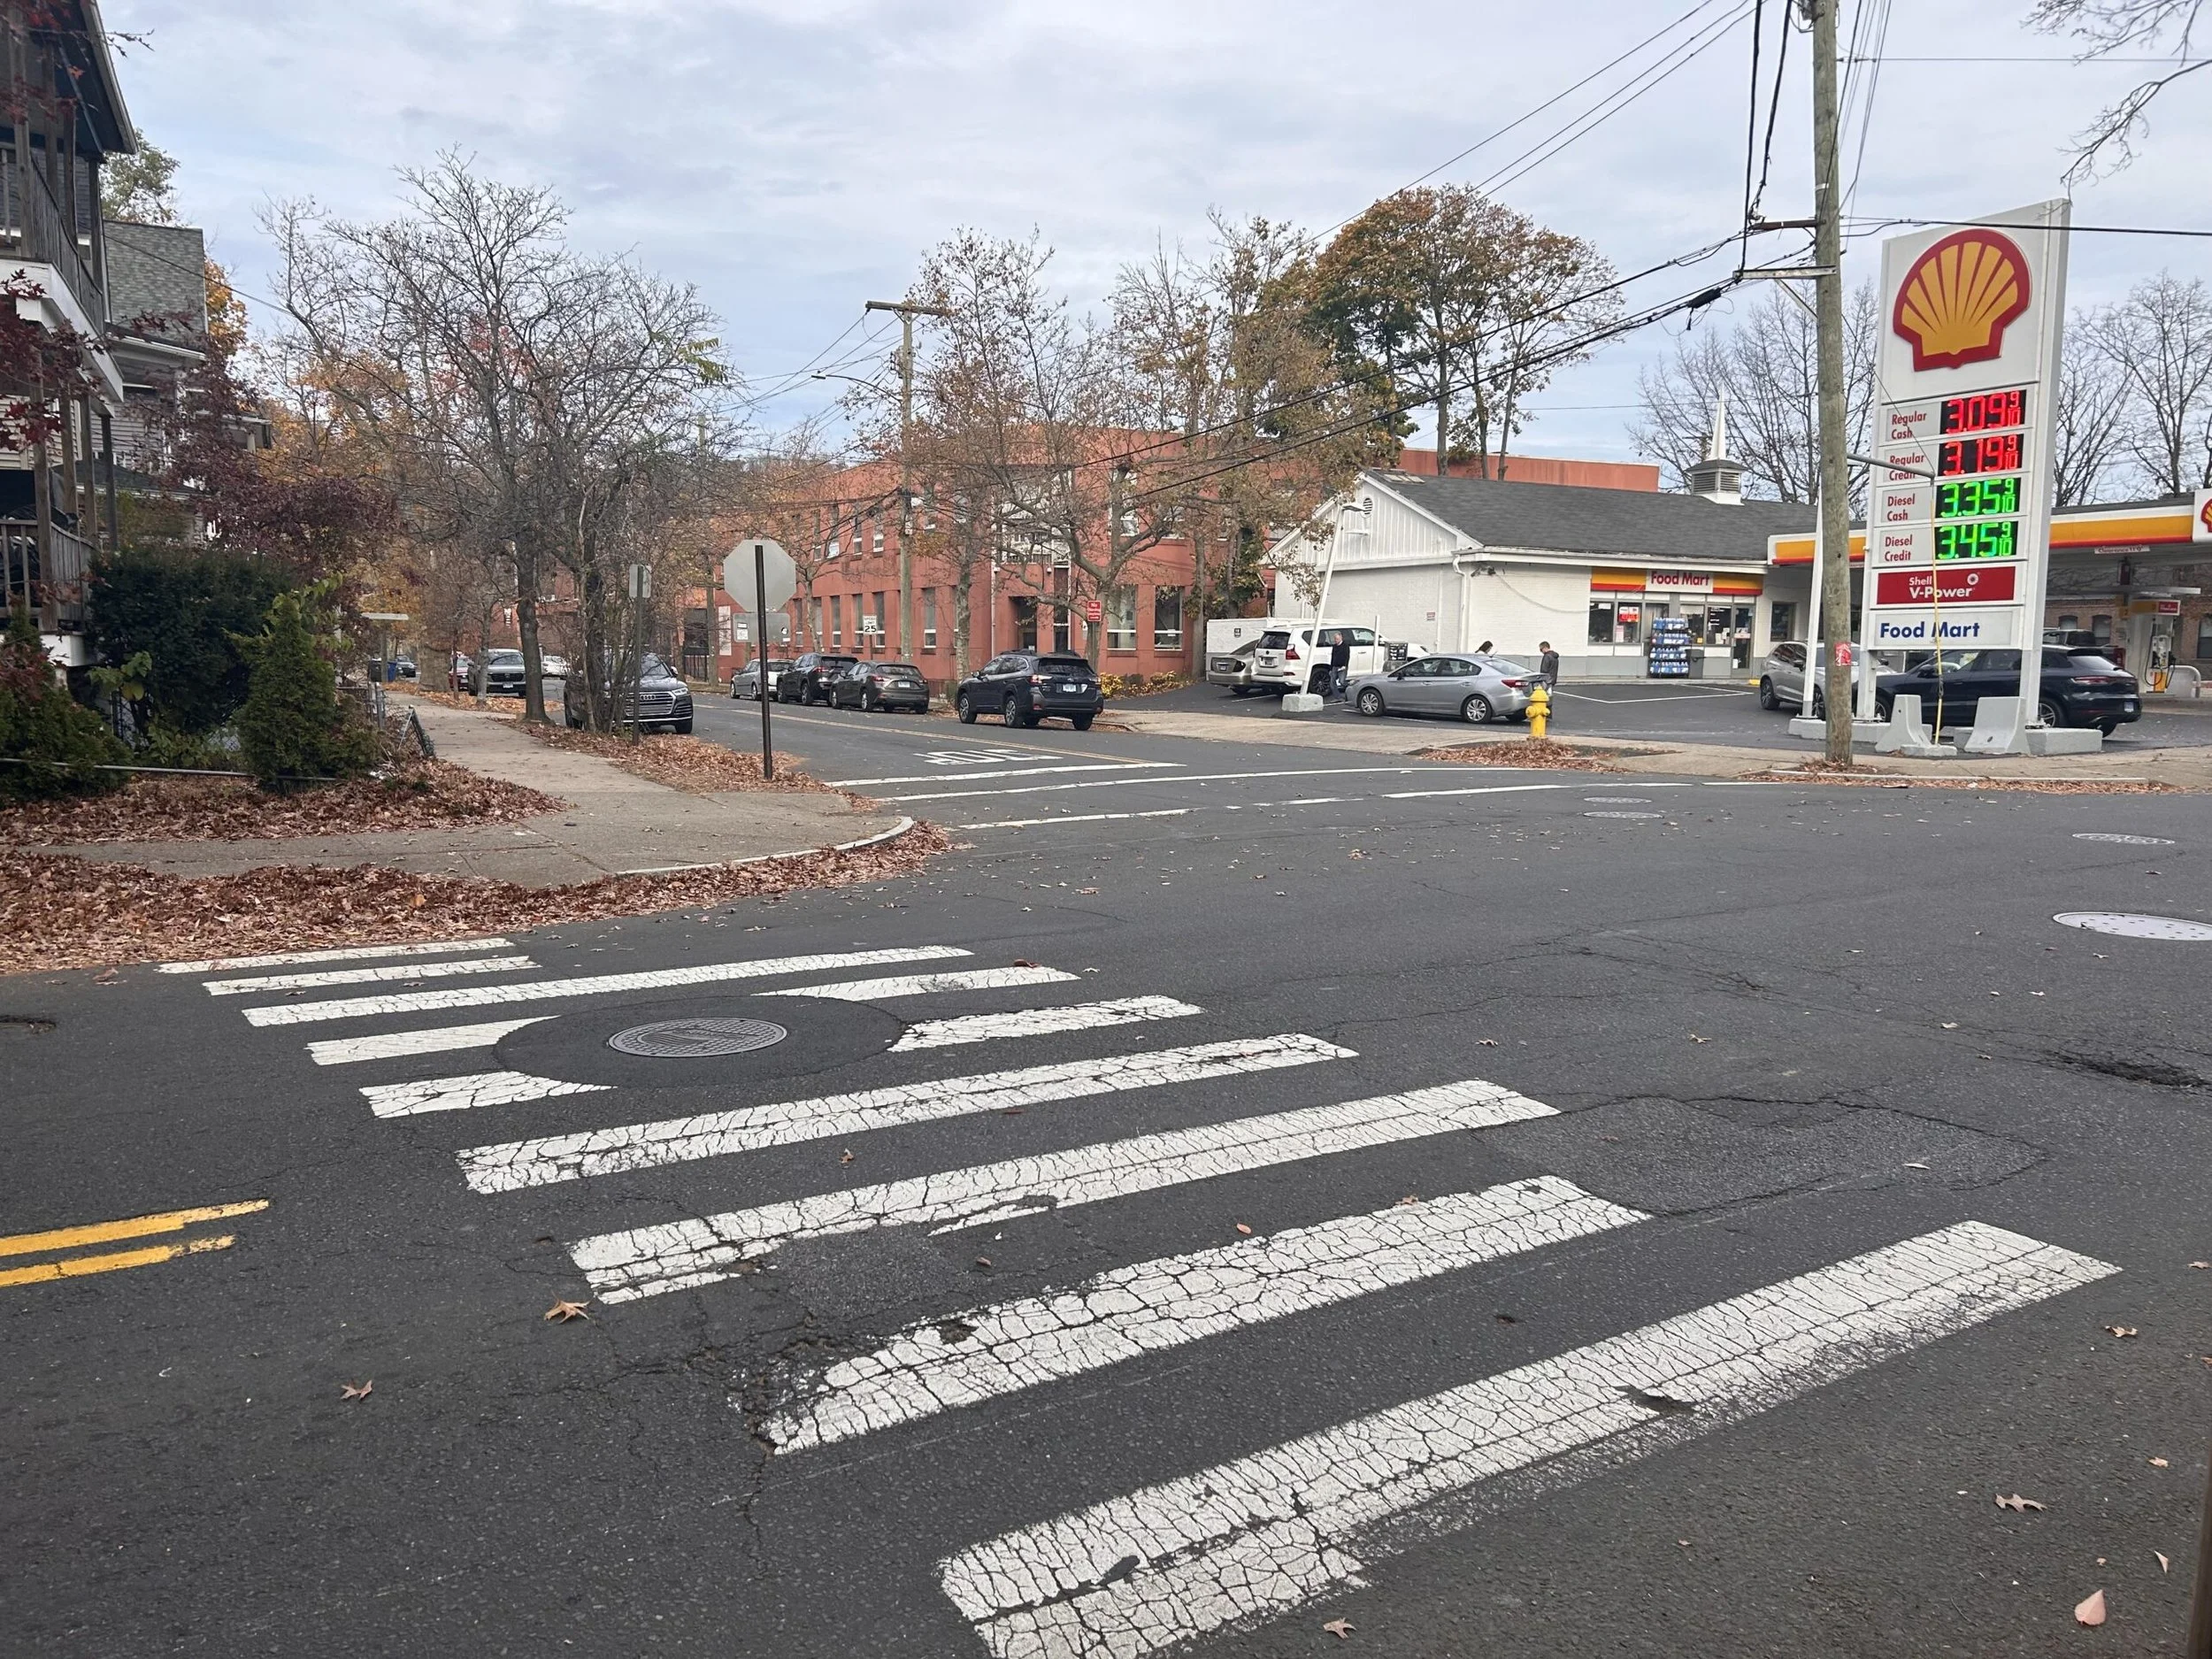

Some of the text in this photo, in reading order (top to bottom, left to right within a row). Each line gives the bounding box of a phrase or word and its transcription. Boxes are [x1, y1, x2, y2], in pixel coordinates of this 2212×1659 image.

[1892, 411, 1927, 426] Regular
[1891, 429, 1913, 440] Cash
[1889, 452, 1924, 466] Regular
[1887, 494, 1916, 507] Diesel
[1886, 511, 1909, 521] Cash
[1885, 534, 1913, 547] Diesel
[1884, 549, 1911, 562] Credit
[1650, 571, 1709, 586] Food Mart
[1909, 575, 1932, 586] Shell
[1909, 586, 1972, 599] V-Power
[1879, 621, 1980, 638] Food Mart
